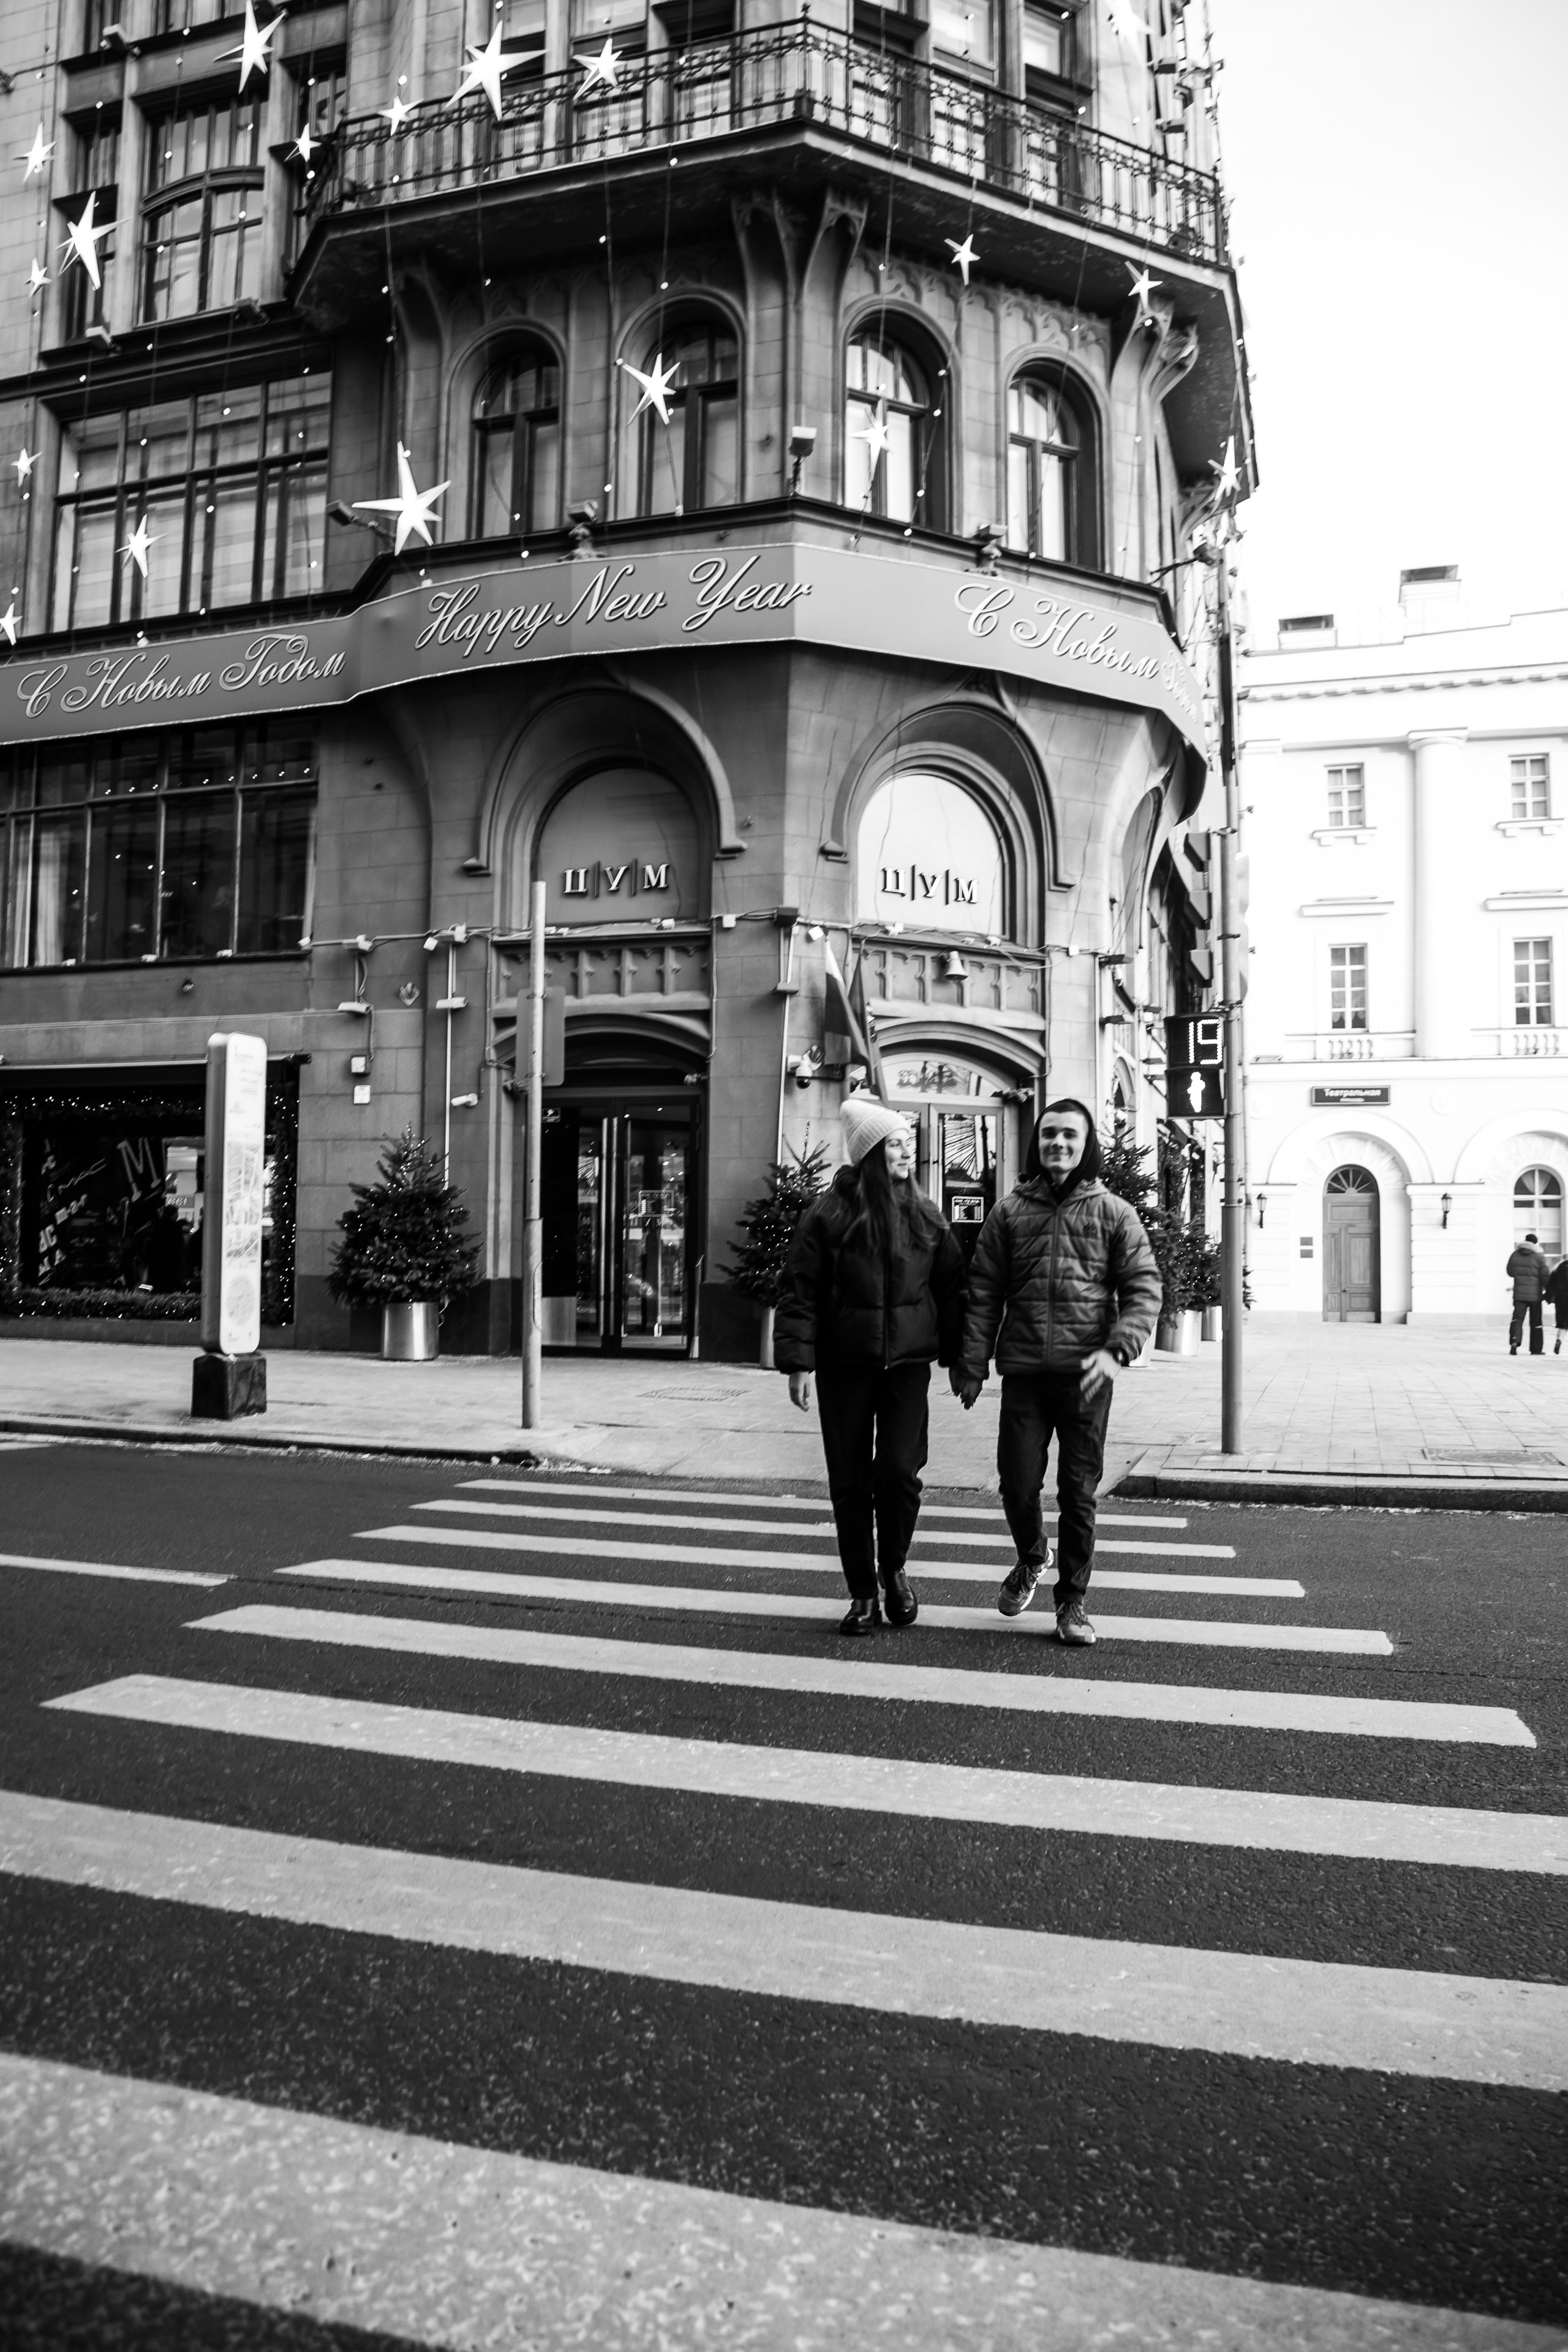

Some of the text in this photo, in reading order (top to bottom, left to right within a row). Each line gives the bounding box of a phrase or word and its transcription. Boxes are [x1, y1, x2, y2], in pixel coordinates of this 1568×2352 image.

[415, 555, 814, 658] Happy New Year
[1009, 597, 1160, 679] Новым
[61, 652, 211, 712] Новым
[219, 634, 346, 692] Годом
[1189, 1019, 1223, 1065] 19
